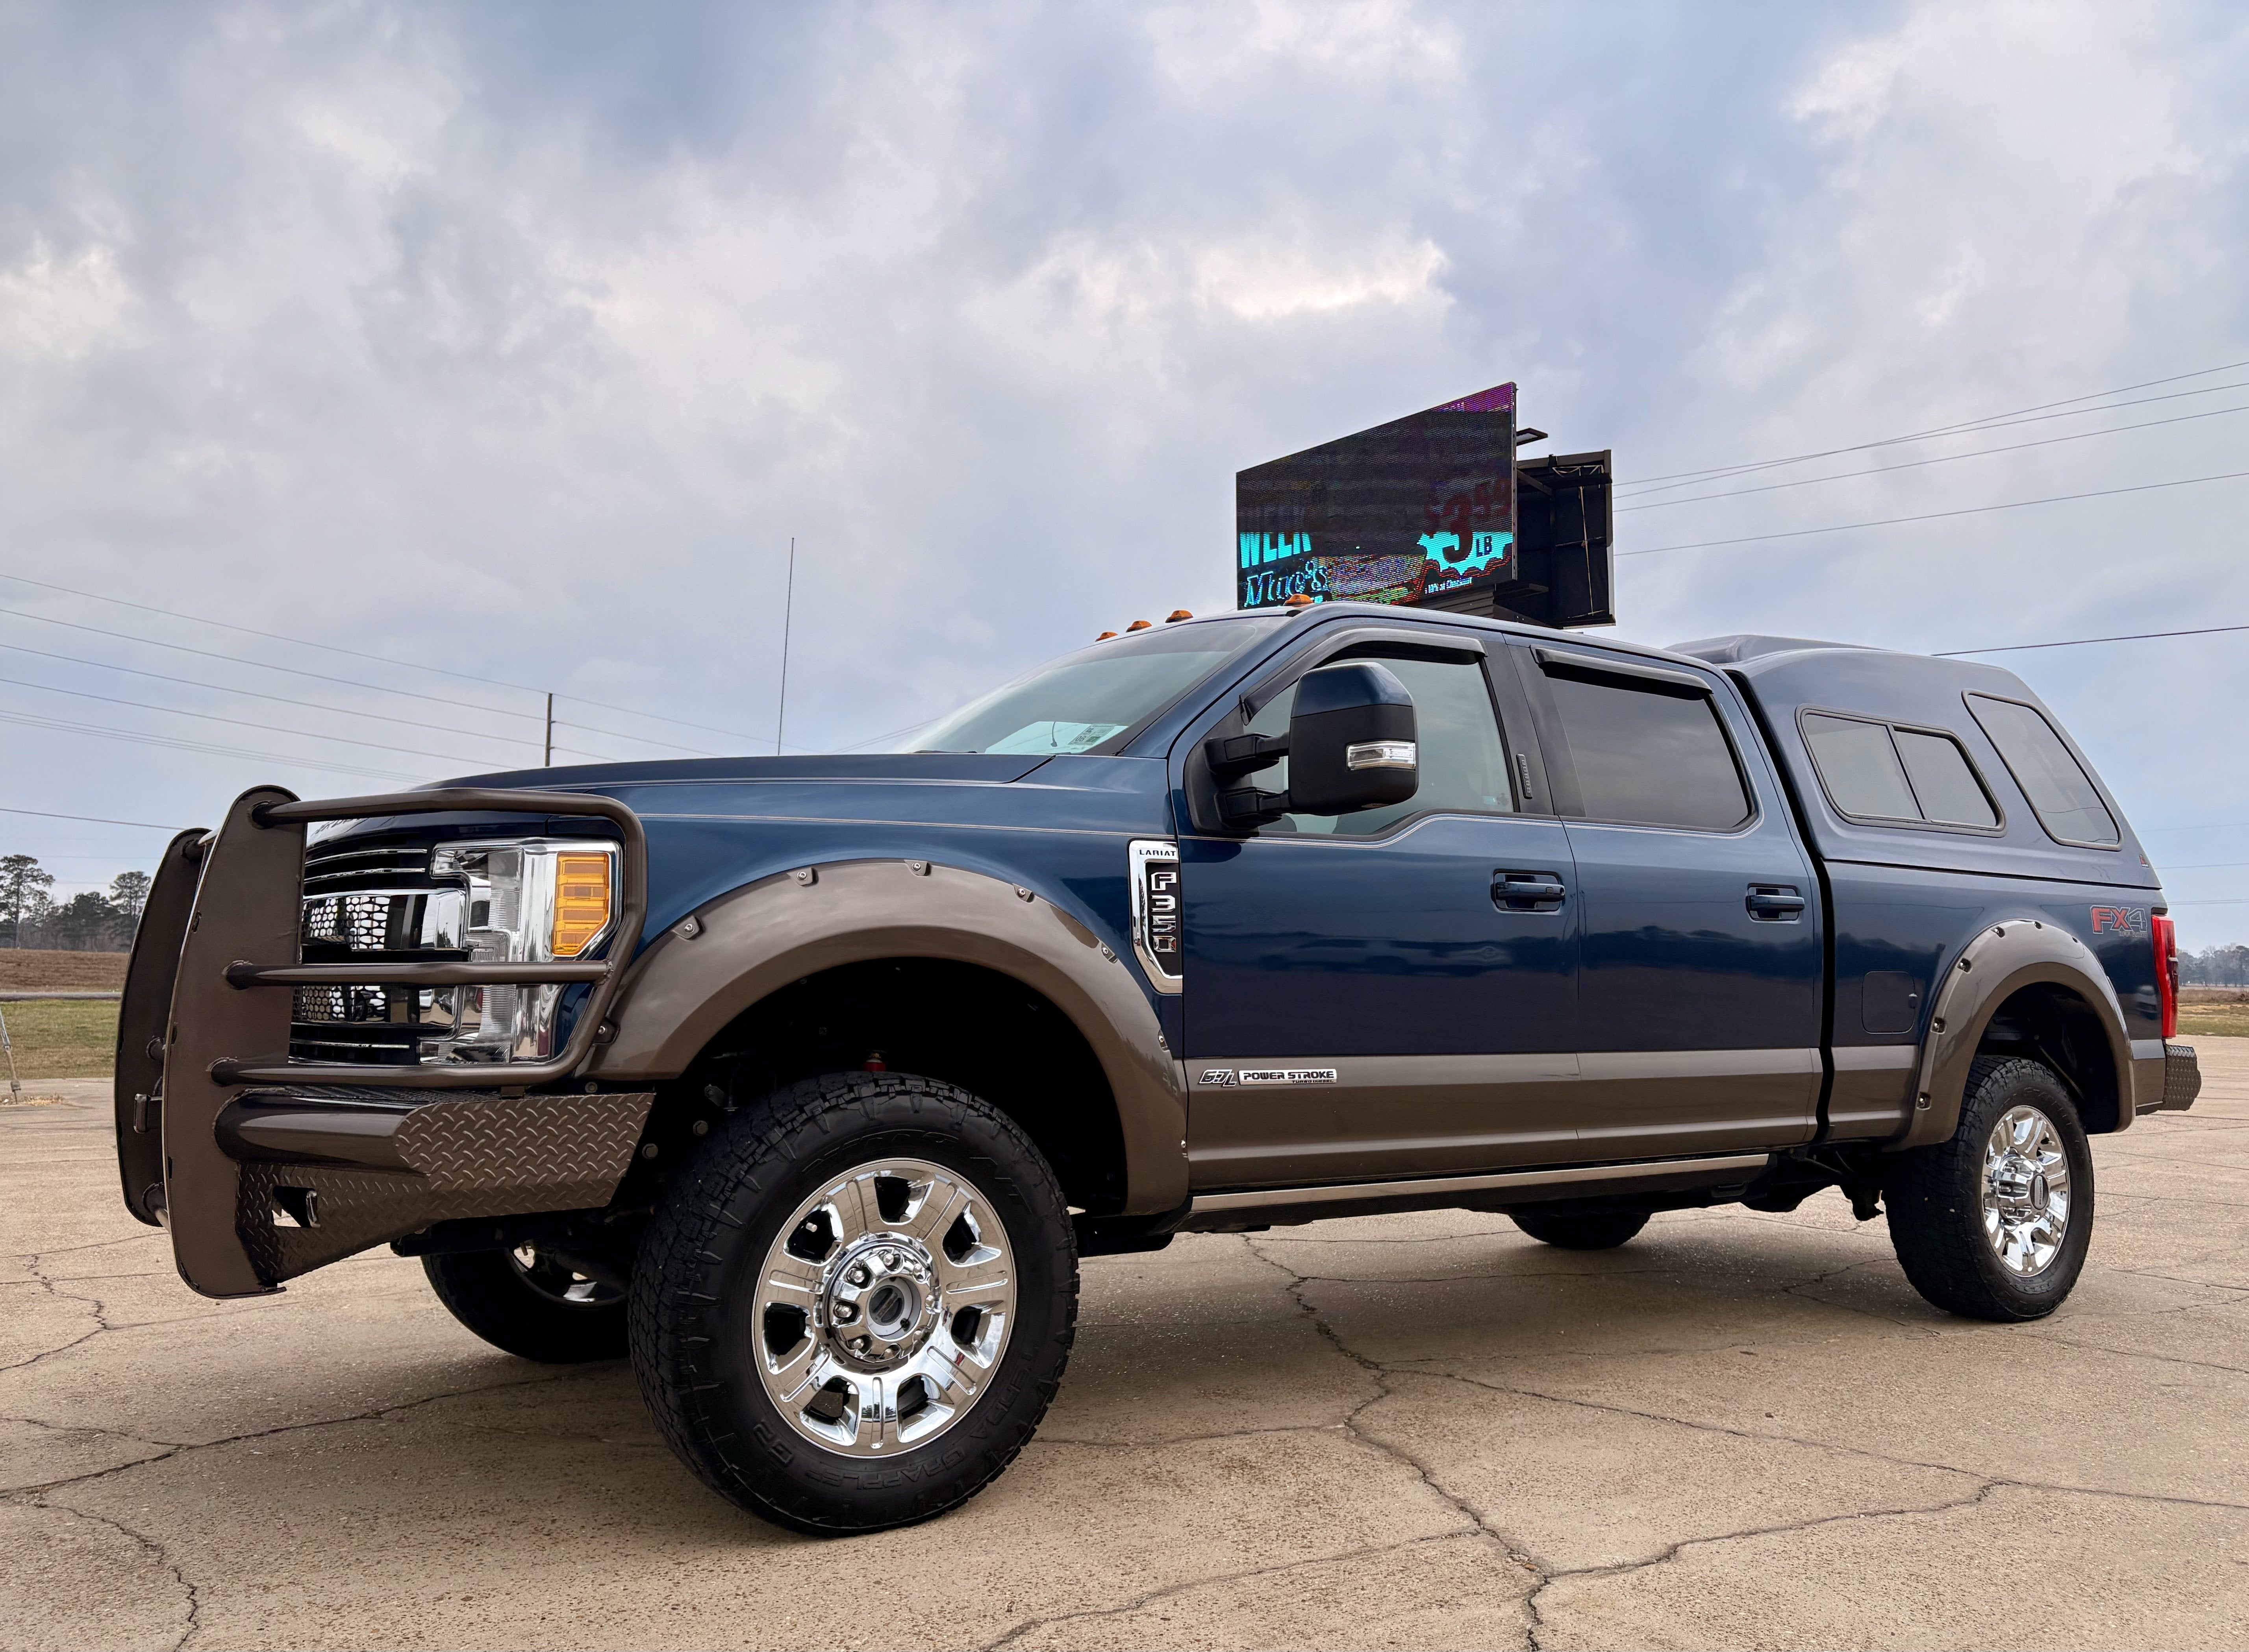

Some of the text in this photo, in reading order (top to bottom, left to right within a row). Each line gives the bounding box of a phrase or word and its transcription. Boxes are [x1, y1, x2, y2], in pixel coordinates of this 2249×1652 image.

[1150, 872, 1176, 953] F350
[2090, 905, 2147, 934] FX4
[1198, 1069, 1335, 1087] 6.7L POWER STROKE
